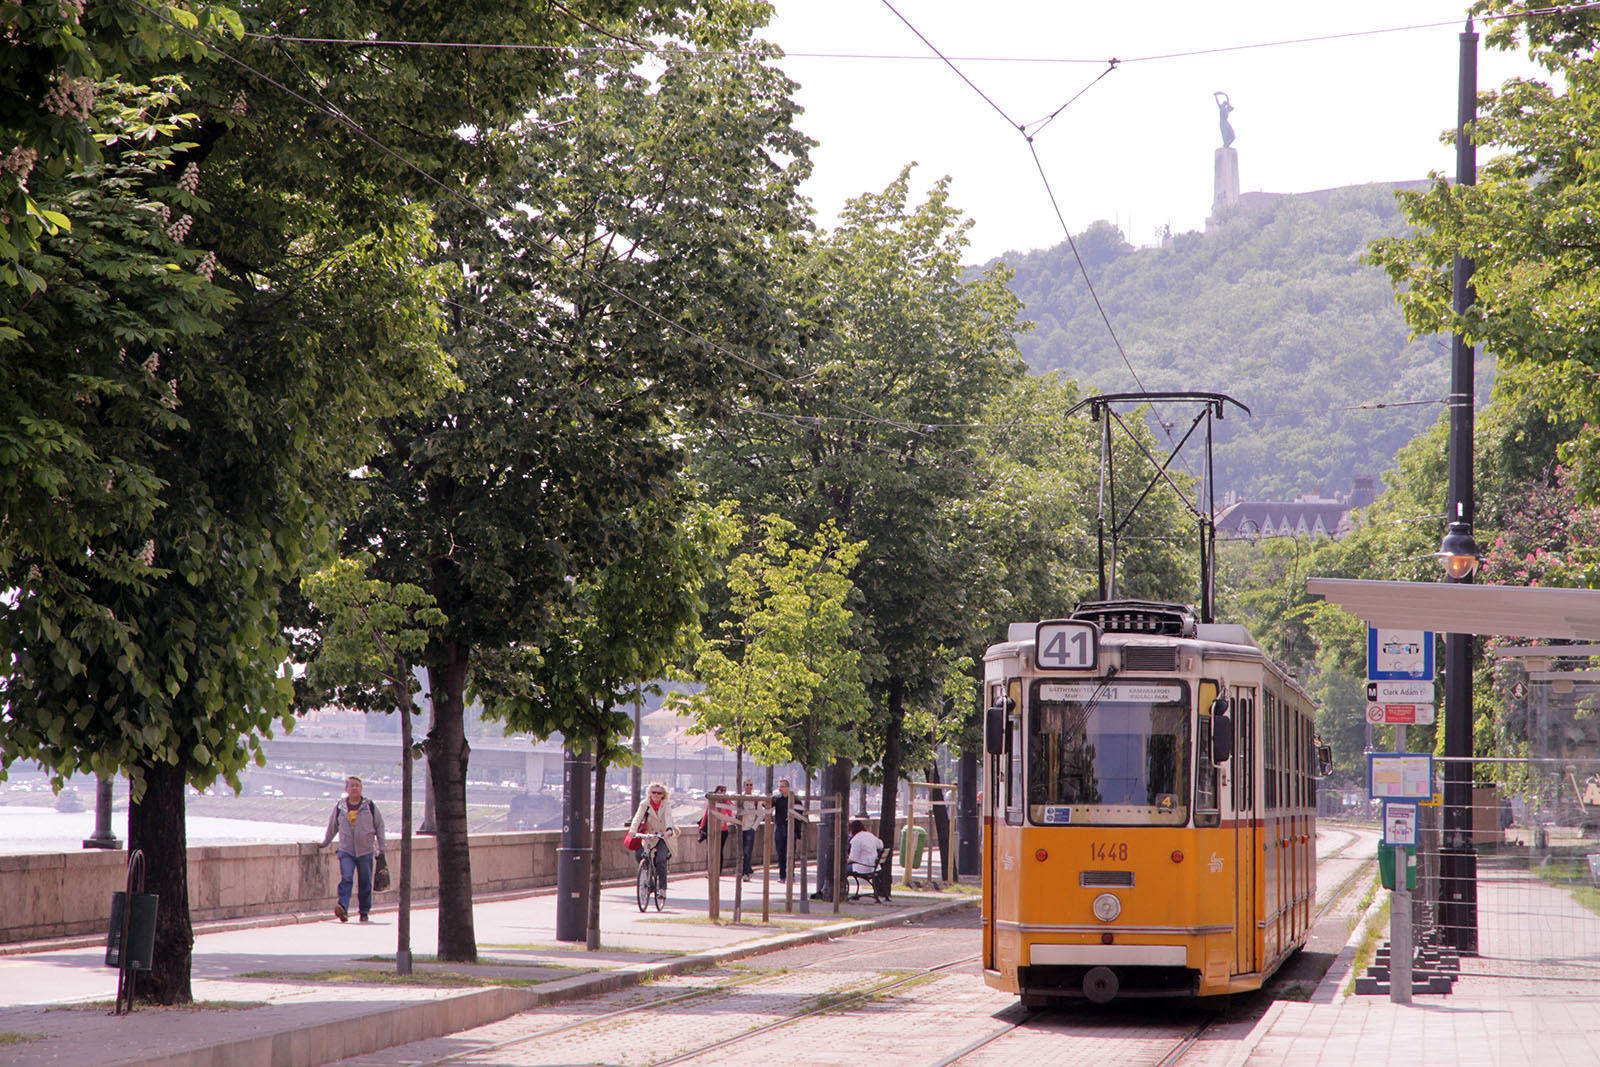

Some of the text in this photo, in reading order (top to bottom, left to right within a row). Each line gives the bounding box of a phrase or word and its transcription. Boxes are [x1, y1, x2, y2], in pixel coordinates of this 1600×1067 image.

[1043, 631, 1087, 664] 41
[1102, 687, 1118, 700] 41
[1369, 688, 1376, 697] M
[1383, 688, 1398, 696] Clark
[1162, 796, 1171, 807] 4
[1091, 842, 1129, 861] 1448
